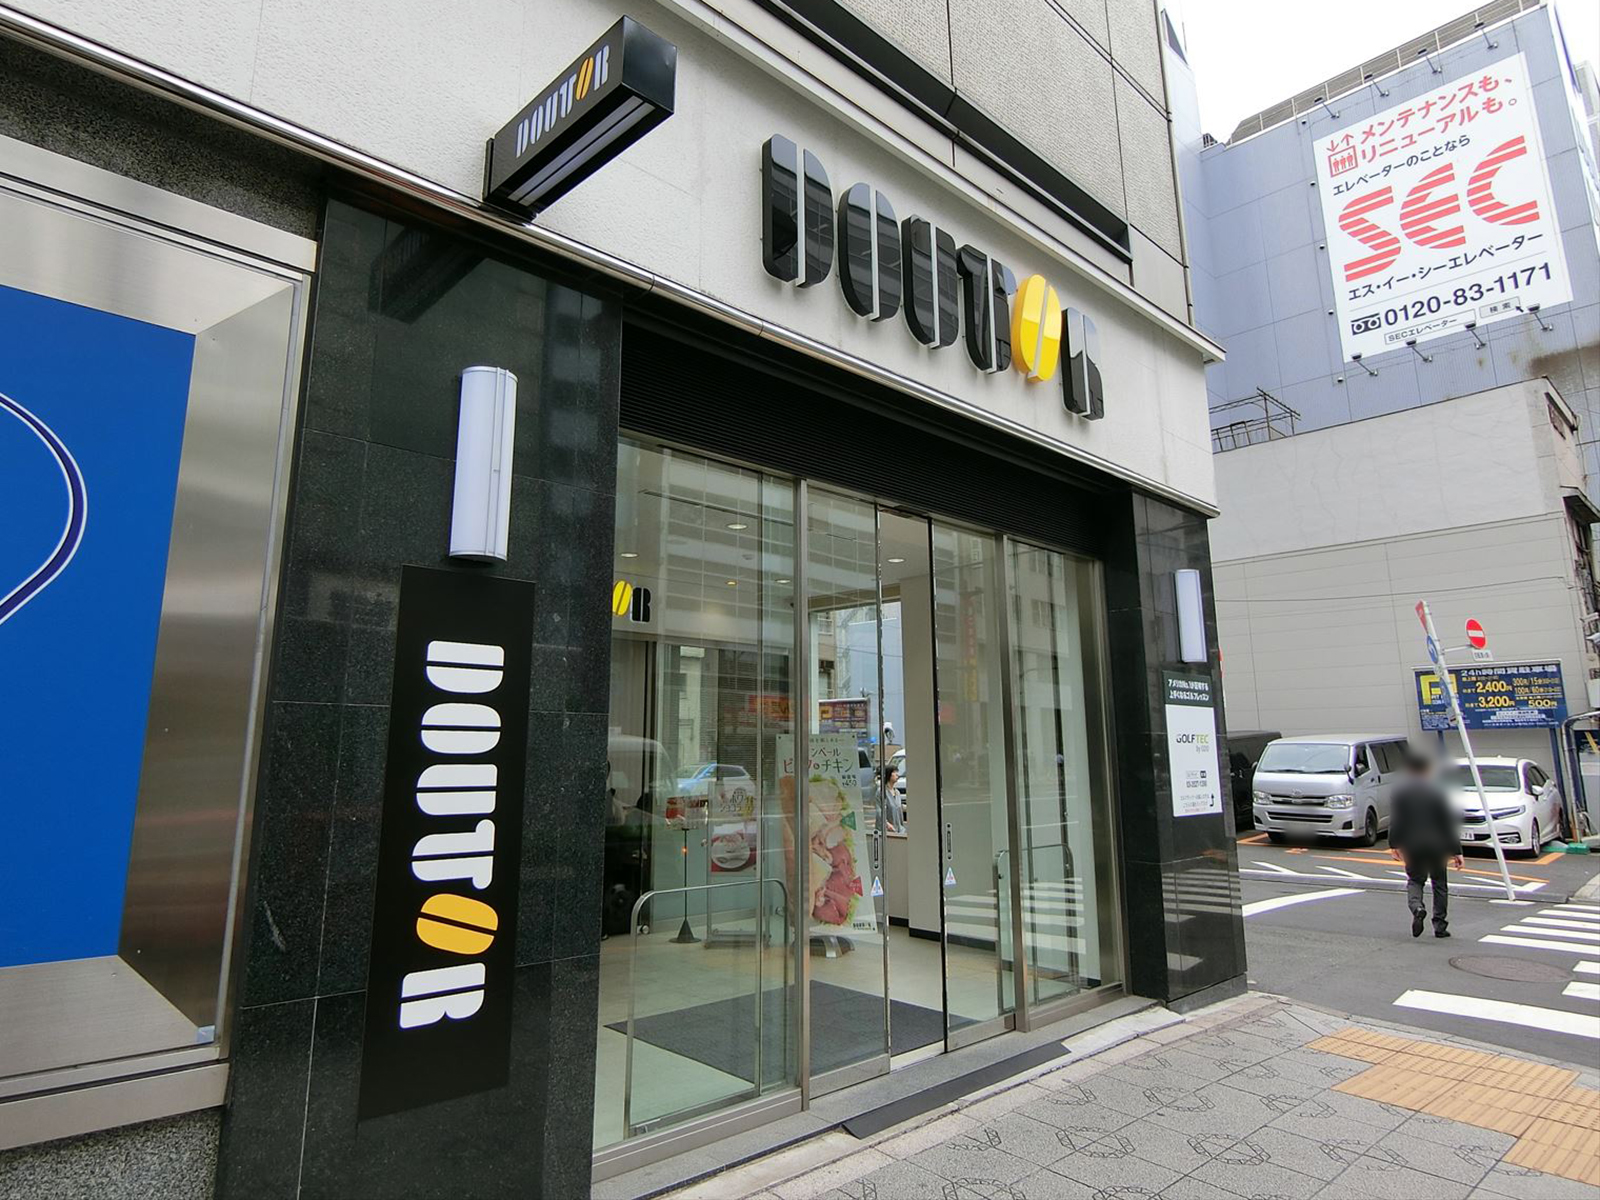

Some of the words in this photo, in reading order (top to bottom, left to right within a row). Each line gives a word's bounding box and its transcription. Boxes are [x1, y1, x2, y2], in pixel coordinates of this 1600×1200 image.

[516, 45, 609, 158] DOUTOR
[1361, 75, 1512, 144] メンテナンスも、
[1361, 97, 1517, 163] リニューアルも。
[1333, 135, 1471, 196] エレベーターのことなら
[1338, 135, 1540, 282] SEC
[761, 134, 1104, 421] DOUTOR
[1348, 234, 1543, 300] エス・イー・シーエレベーター
[1385, 262, 1551, 326] 0120-83-1171
[1388, 318, 1457, 342] SECエレベーター
[1176, 733, 1209, 744] GOLFTEC
[399, 640, 505, 1029] DOUTOR
